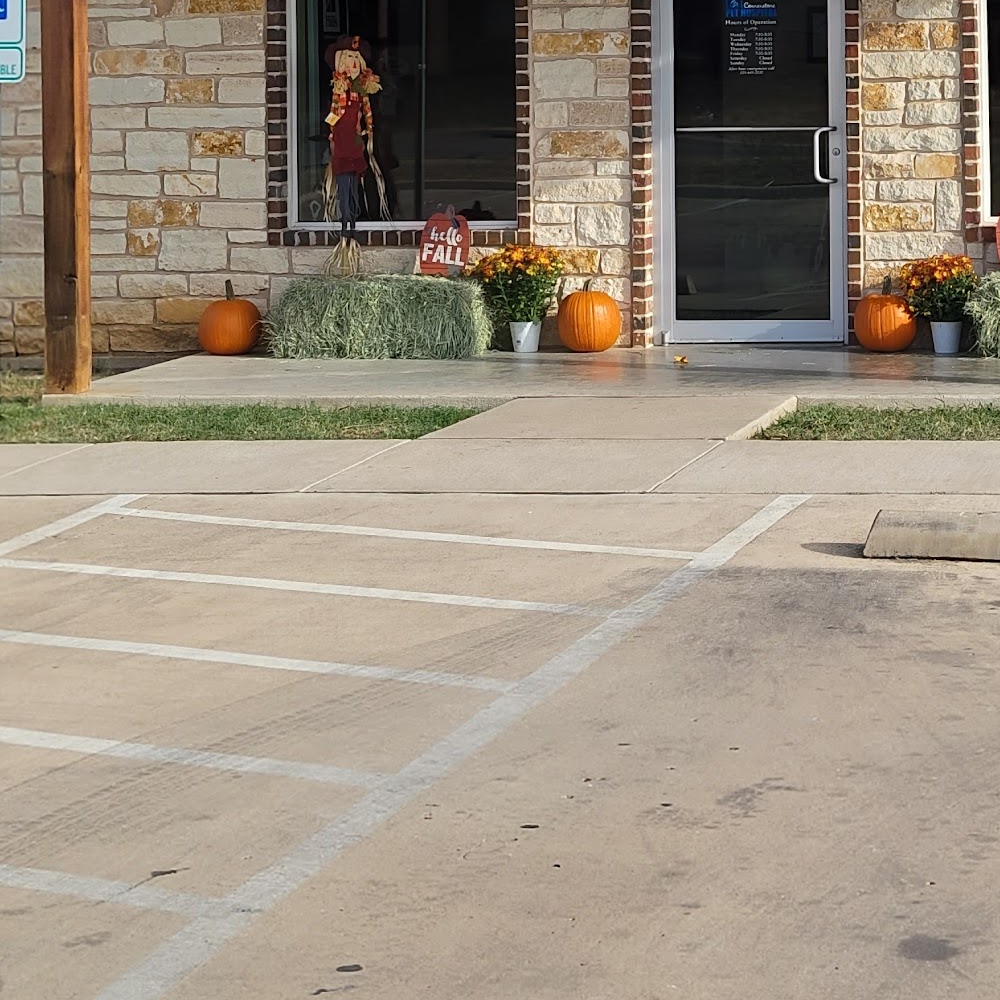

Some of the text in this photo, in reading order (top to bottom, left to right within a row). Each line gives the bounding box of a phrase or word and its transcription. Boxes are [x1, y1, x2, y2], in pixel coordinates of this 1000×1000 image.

[743, 1, 776, 9] Cornerstone
[726, 8, 777, 17] PET HOSPITAL
[430, 226, 463, 246] hello
[422, 243, 465, 267] FALL
